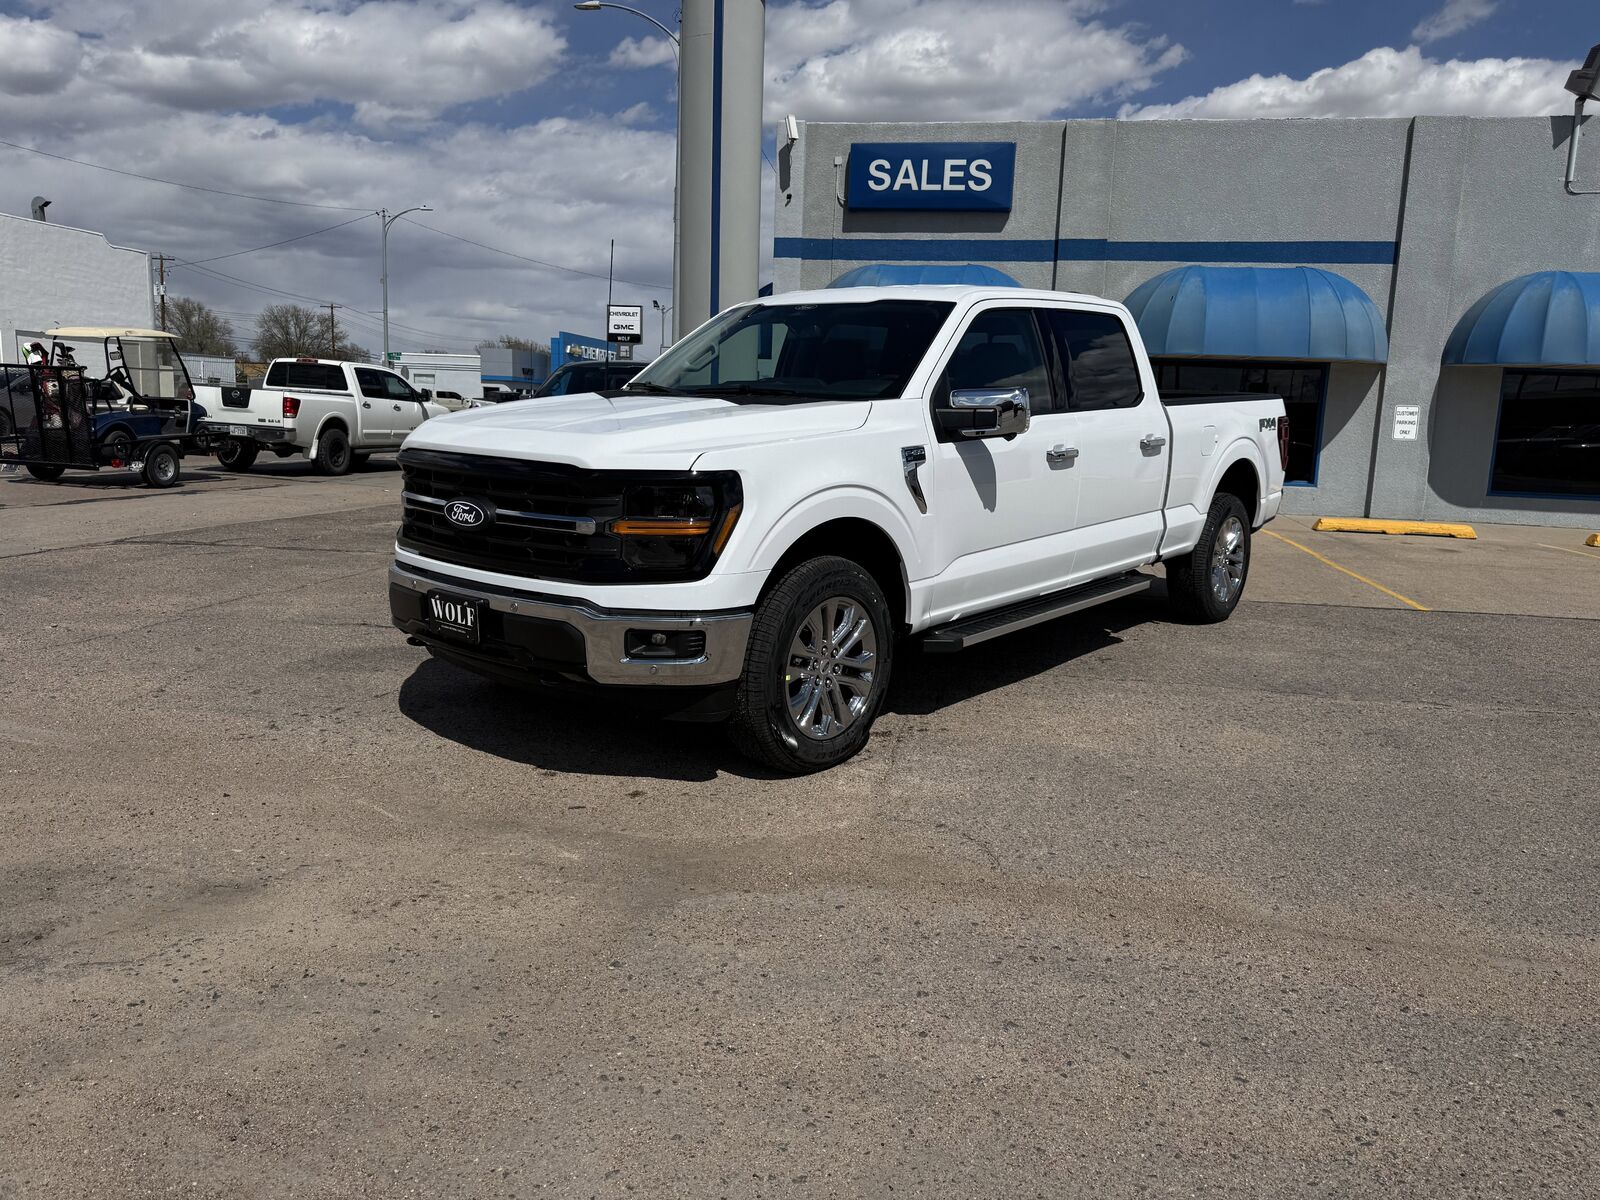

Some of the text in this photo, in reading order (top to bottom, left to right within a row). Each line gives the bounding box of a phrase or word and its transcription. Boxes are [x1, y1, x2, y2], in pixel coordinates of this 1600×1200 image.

[867, 159, 993, 192] SALES
[1259, 417, 1276, 432] FX4
[451, 503, 476, 523] Ford
[430, 598, 475, 626] WOLF
